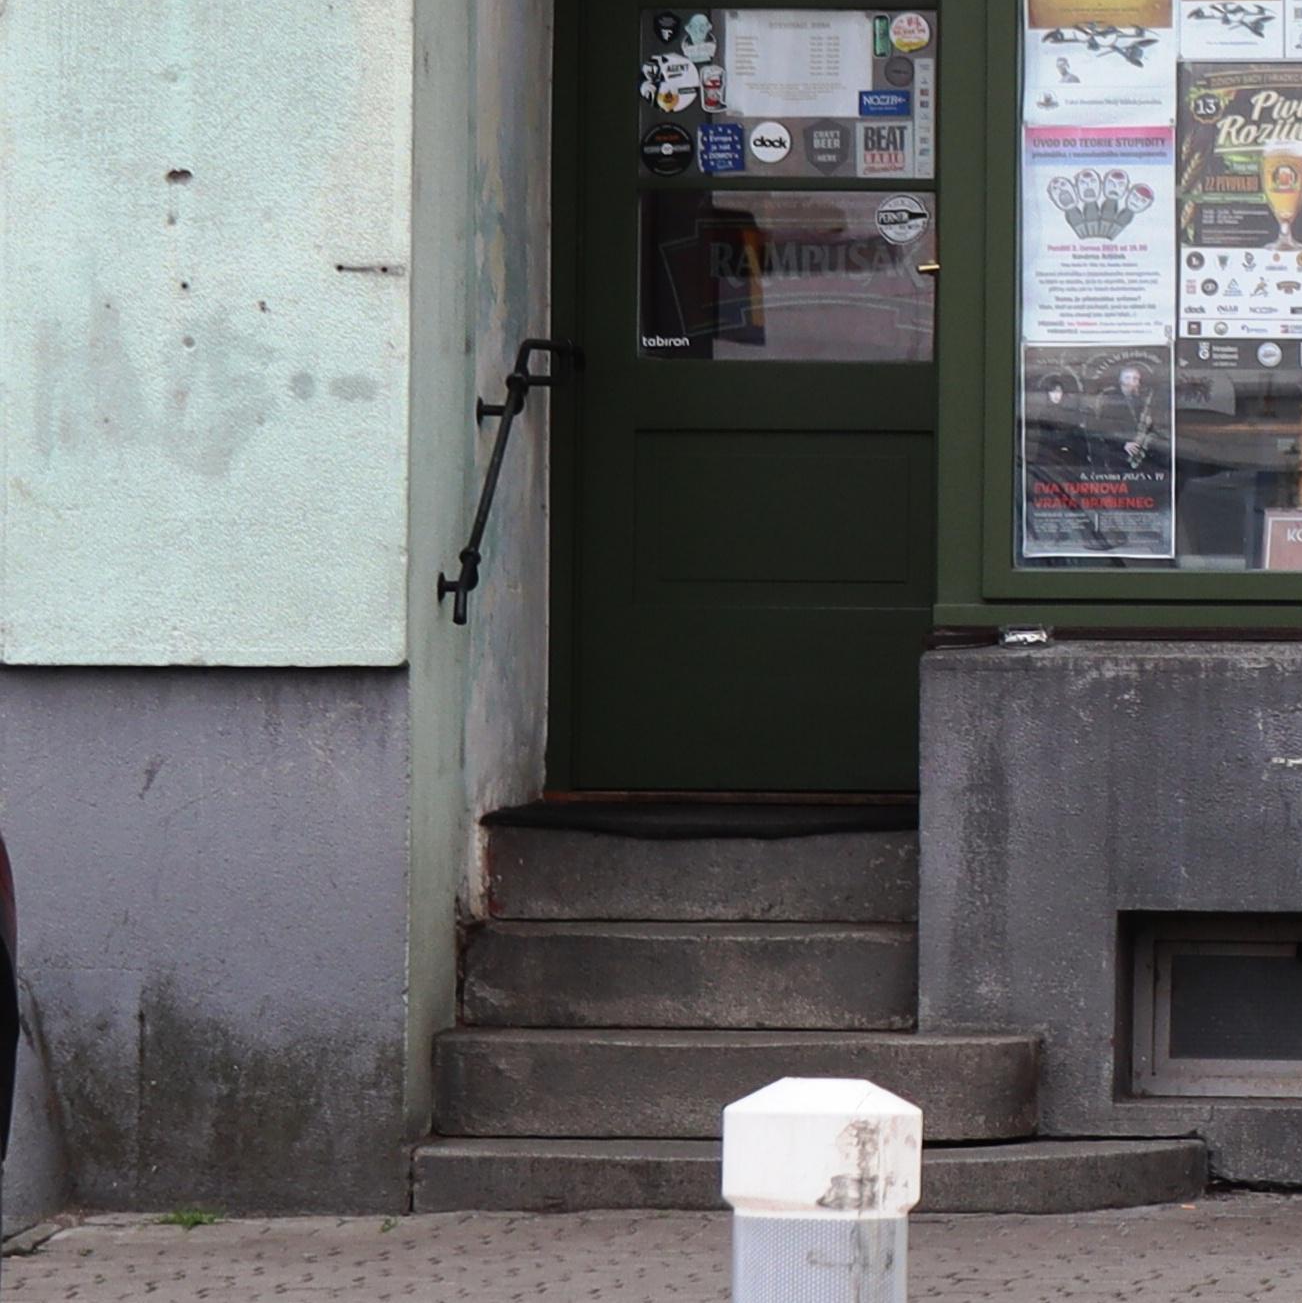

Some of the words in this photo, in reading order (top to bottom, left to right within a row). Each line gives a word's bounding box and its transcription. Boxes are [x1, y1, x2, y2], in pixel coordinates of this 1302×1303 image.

[666, 63, 690, 73] AGENT
[1197, 99, 1217, 115] 13
[864, 126, 907, 151] BEAT
[1063, 138, 1076, 148] DO
[1080, 138, 1115, 148] TEORIE
[1115, 137, 1165, 148] STUPIDITY
[642, 335, 690, 347] tabiron
[1034, 482, 1059, 494] EVA
[1063, 481, 1129, 494] TURNOVÁ
